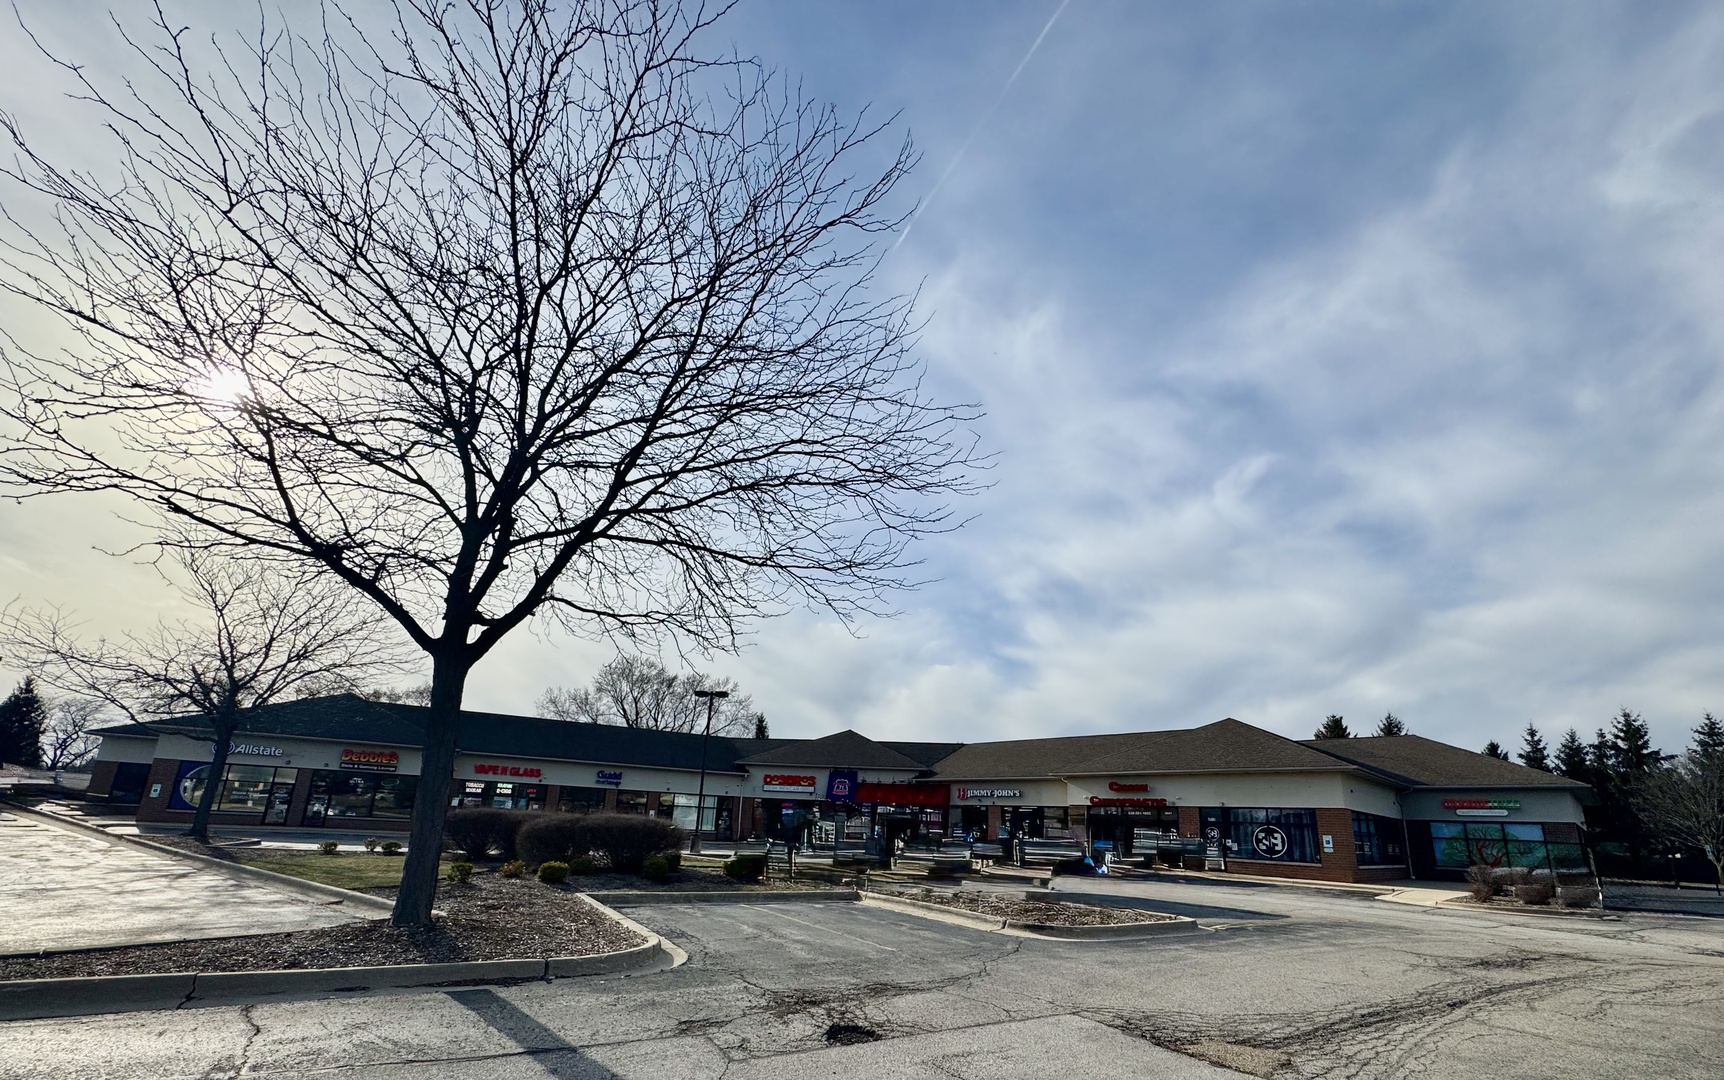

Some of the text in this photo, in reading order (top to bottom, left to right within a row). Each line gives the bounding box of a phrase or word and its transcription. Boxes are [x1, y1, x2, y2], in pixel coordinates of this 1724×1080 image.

[234, 744, 283, 756] Allstate
[509, 767, 542, 778] GLASS
[596, 770, 622, 781] Guild
[967, 789, 1020, 798] JIMMY JOHN'S
